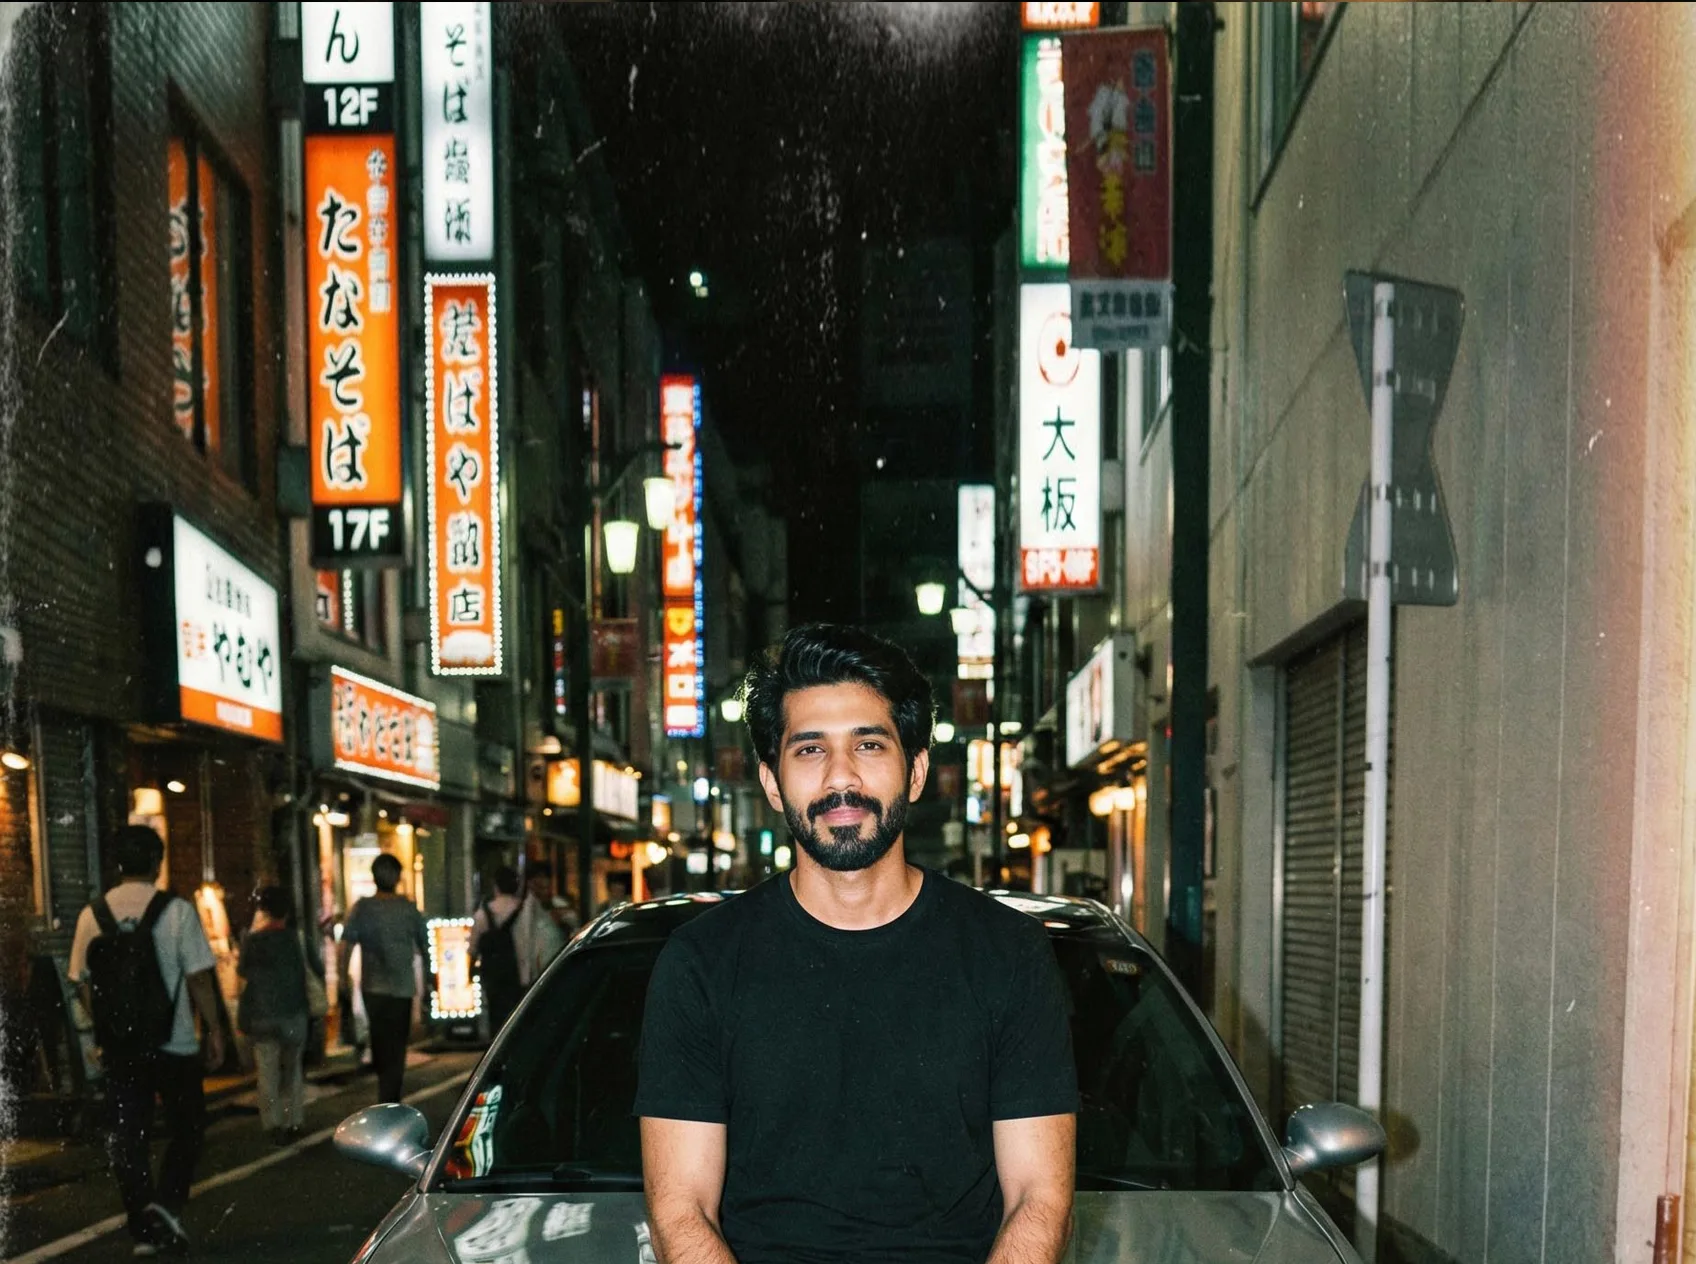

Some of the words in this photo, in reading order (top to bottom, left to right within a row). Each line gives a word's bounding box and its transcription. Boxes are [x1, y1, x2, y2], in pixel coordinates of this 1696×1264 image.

[323, 87, 379, 126] 12F
[1041, 405, 1077, 533] 大板
[328, 508, 390, 550] 17F
